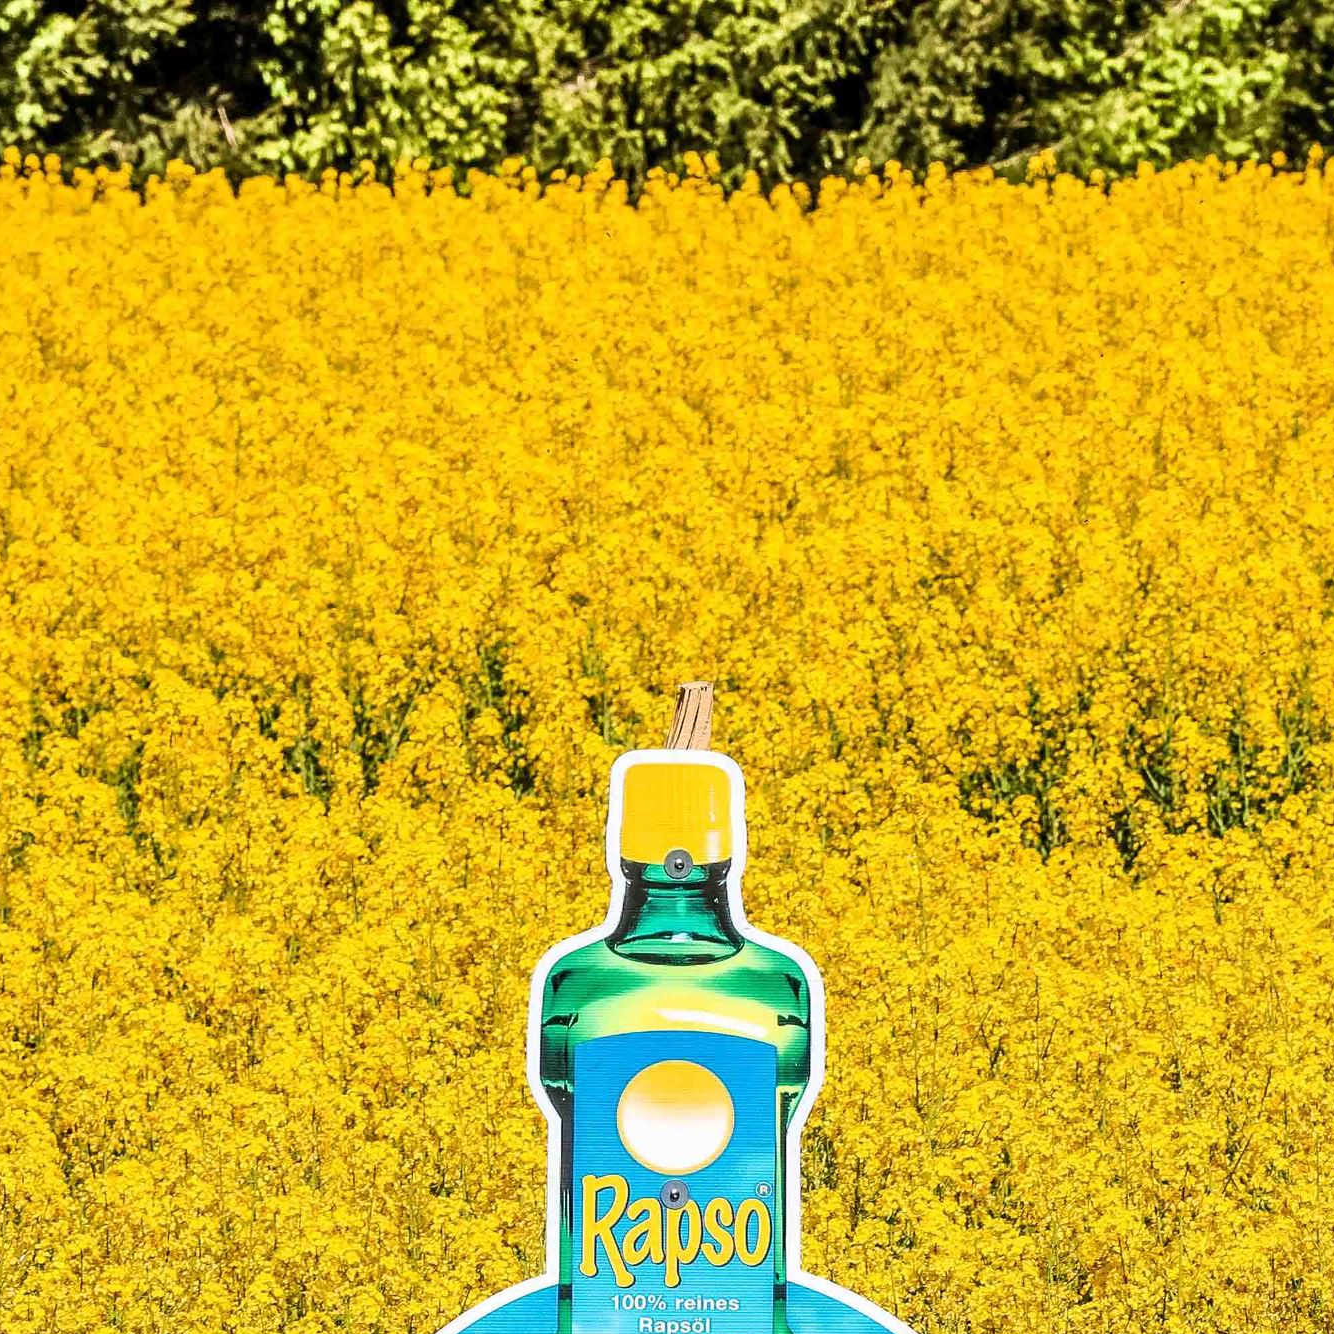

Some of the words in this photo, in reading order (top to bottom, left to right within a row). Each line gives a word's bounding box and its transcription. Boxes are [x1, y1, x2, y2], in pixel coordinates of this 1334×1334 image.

[610, 1295, 667, 1311] 100%
[675, 1295, 740, 1311] reines
[638, 1317, 711, 1334] Rapsöl
